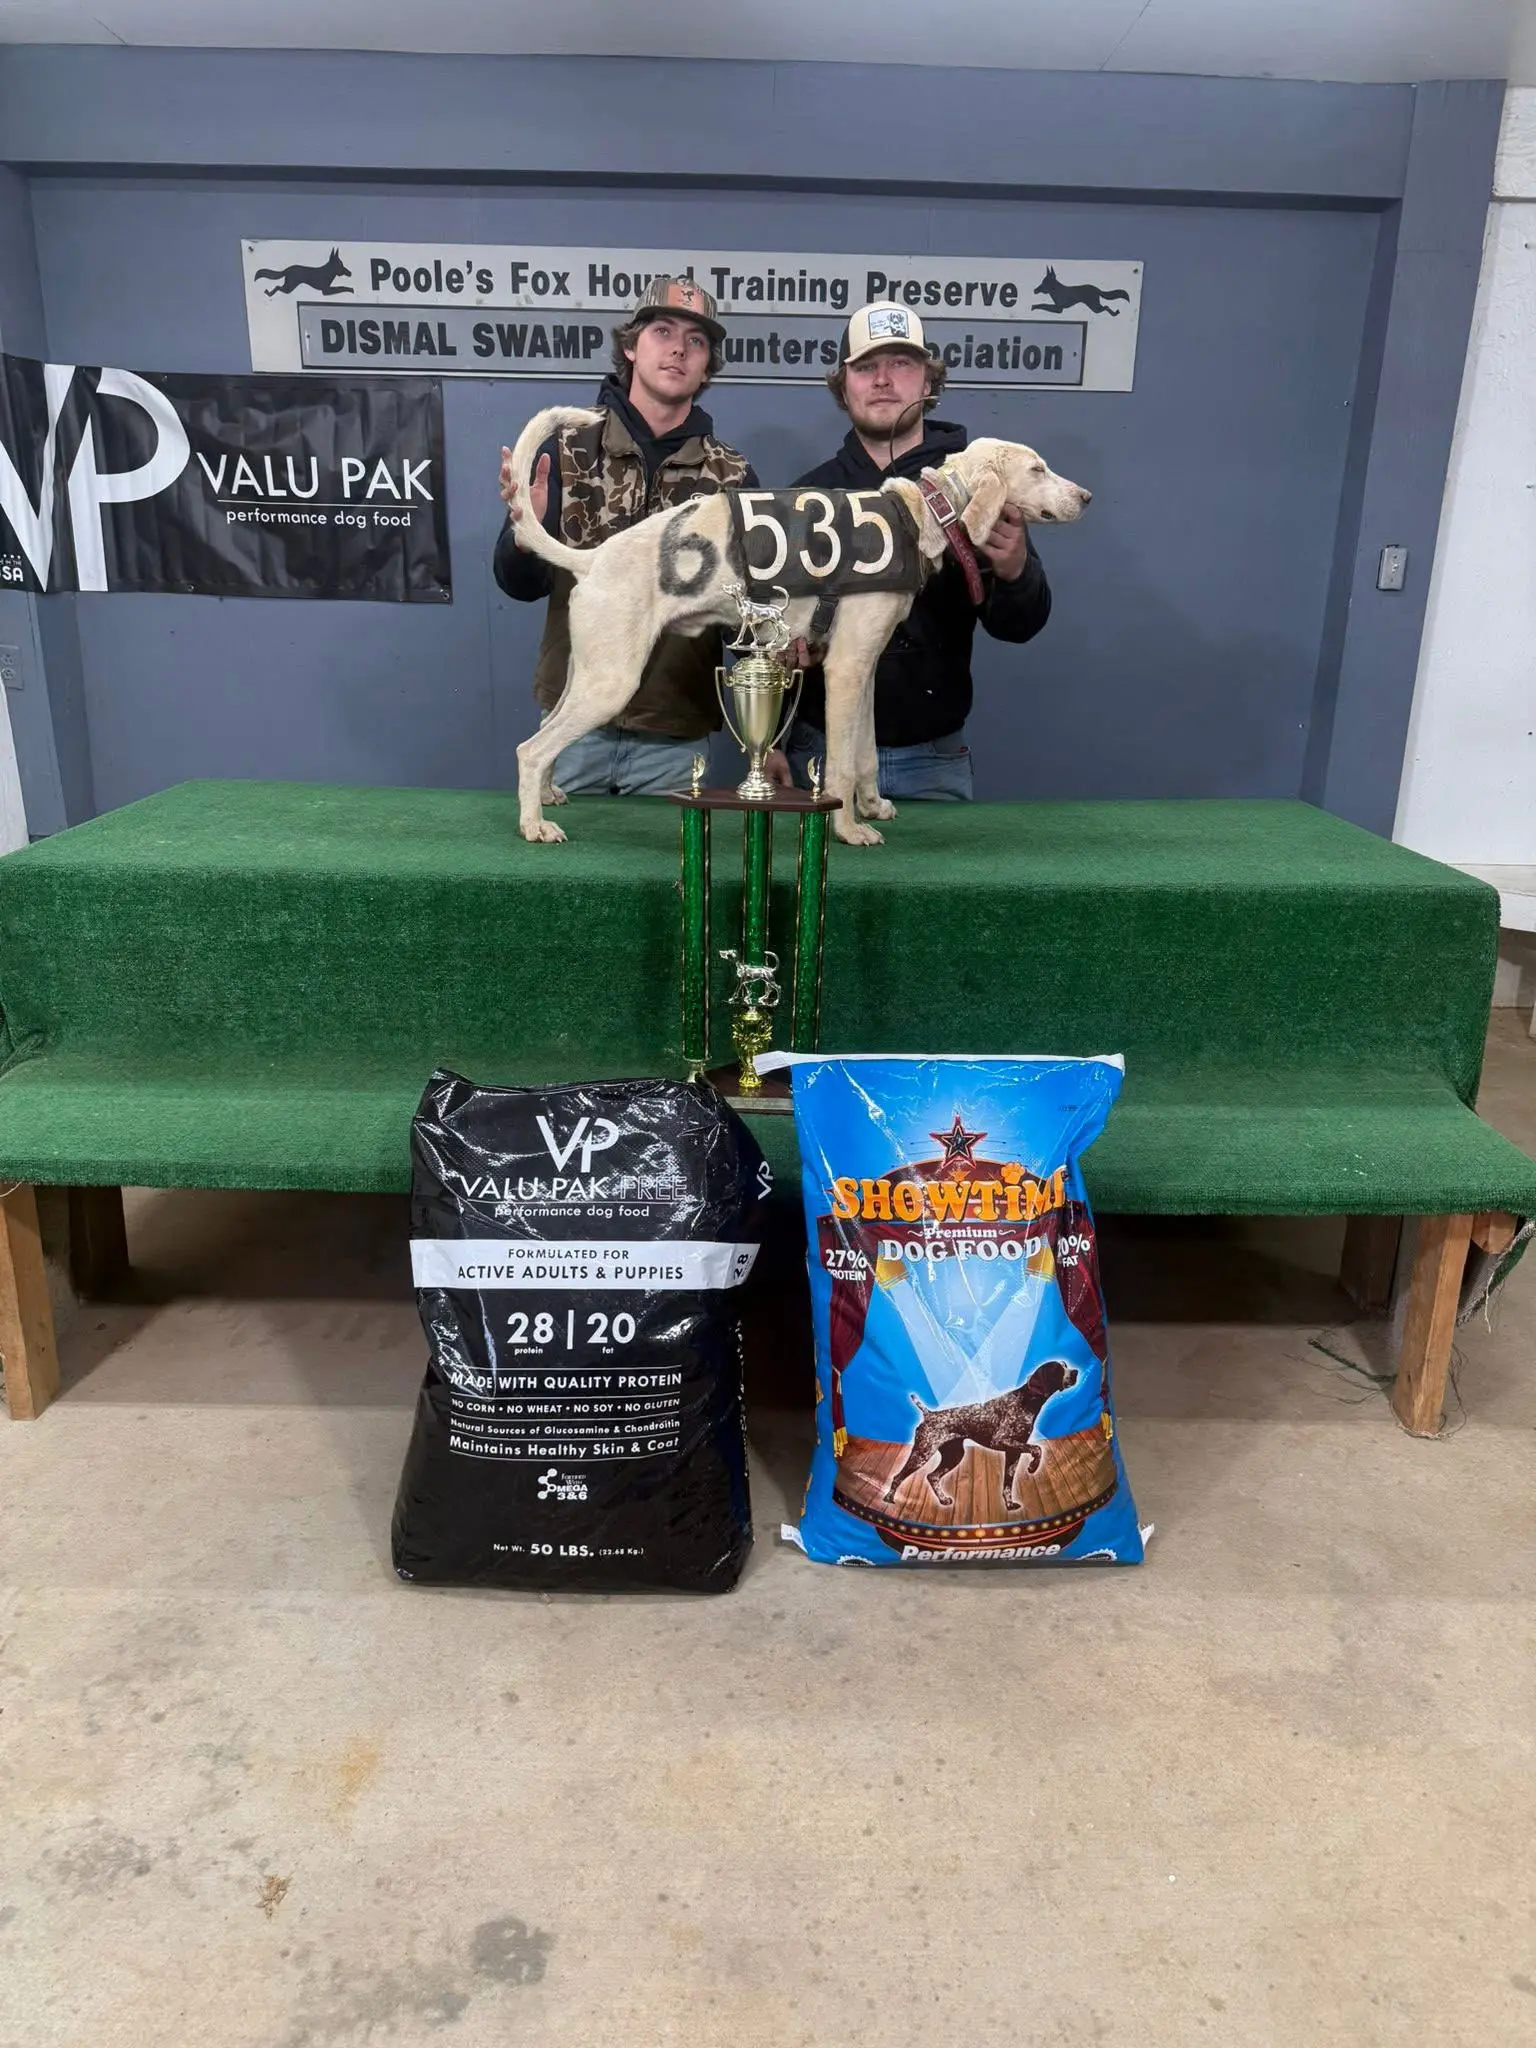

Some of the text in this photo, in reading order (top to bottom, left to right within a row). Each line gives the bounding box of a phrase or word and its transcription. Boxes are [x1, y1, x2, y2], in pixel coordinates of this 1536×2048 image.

[371, 258, 1018, 309] Poole's Fox Hou Training Preserve
[320, 319, 457, 356] DISMAL
[473, 323, 604, 359] SWAMP
[722, 332, 838, 366] unters
[196, 452, 435, 501] VALU PAK
[226, 508, 411, 529] performance dog food
[739, 491, 894, 581] 535
[0, 565, 24, 582] SA
[535, 1115, 620, 1173] VP
[460, 1175, 688, 1201] VALU PAK FREE
[494, 1204, 650, 1219] performance dog food
[924, 1225, 998, 1239] Premium
[508, 1248, 629, 1260] FORMULATED FOR
[882, 1236, 1042, 1262] DOG FOOD
[1057, 1233, 1091, 1257] 0%
[825, 1249, 868, 1269] 27%
[1062, 1255, 1079, 1268] FAT
[458, 1265, 684, 1280] ACTIVE ADULTS & PUPPIES
[506, 1312, 636, 1344] 28 20
[514, 1347, 544, 1355] protein
[450, 1372, 682, 1390] MADE WITH QUALITY PROTEIN
[452, 1398, 681, 1413] NO CORN NO WHEAT NO SOY NO GLUTEN
[450, 1418, 681, 1434] Natural Sources of Glucosamine & Chondroitin
[450, 1435, 679, 1458] Maintains Healthy Skin & Coat
[530, 1543, 553, 1555] 50
[559, 1544, 595, 1557] LBS.
[901, 1542, 1060, 1562] Performance
